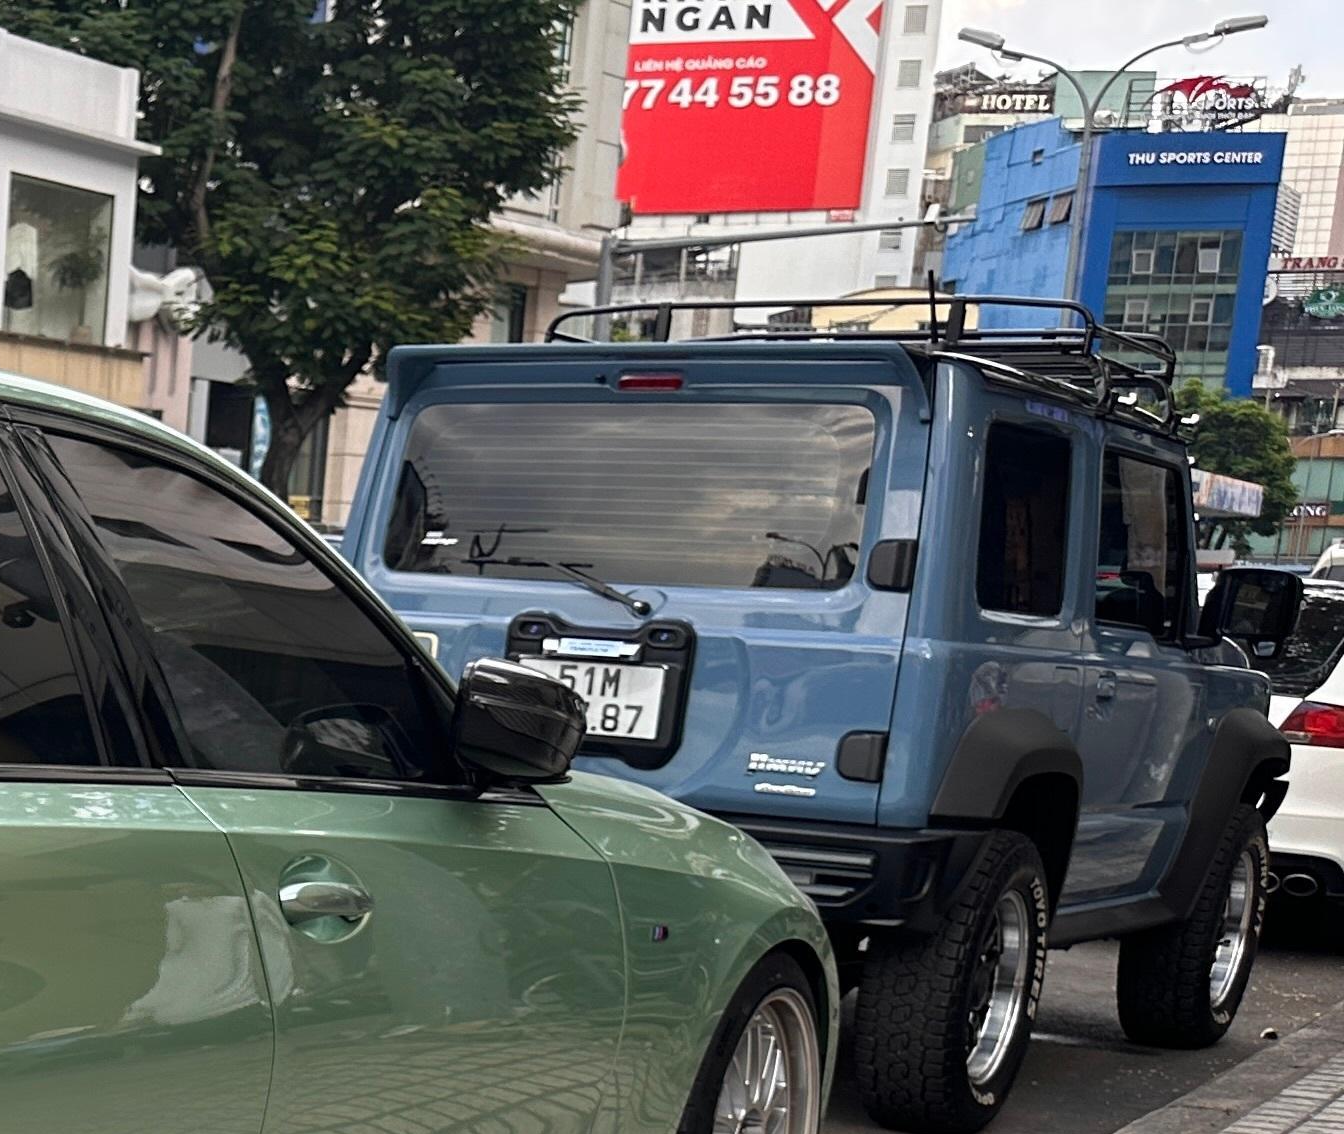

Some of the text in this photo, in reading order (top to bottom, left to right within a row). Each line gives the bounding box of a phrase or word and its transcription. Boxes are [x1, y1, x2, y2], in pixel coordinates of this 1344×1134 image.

[727, 75, 780, 108] 55
[787, 73, 841, 106] 88
[981, 94, 1051, 111] HOTEL
[1128, 150, 1263, 165] THU SPORTS CENTER
[559, 664, 622, 698] 51M
[1030, 877, 1048, 928] TOYO
[1026, 931, 1047, 1022] TIRES
